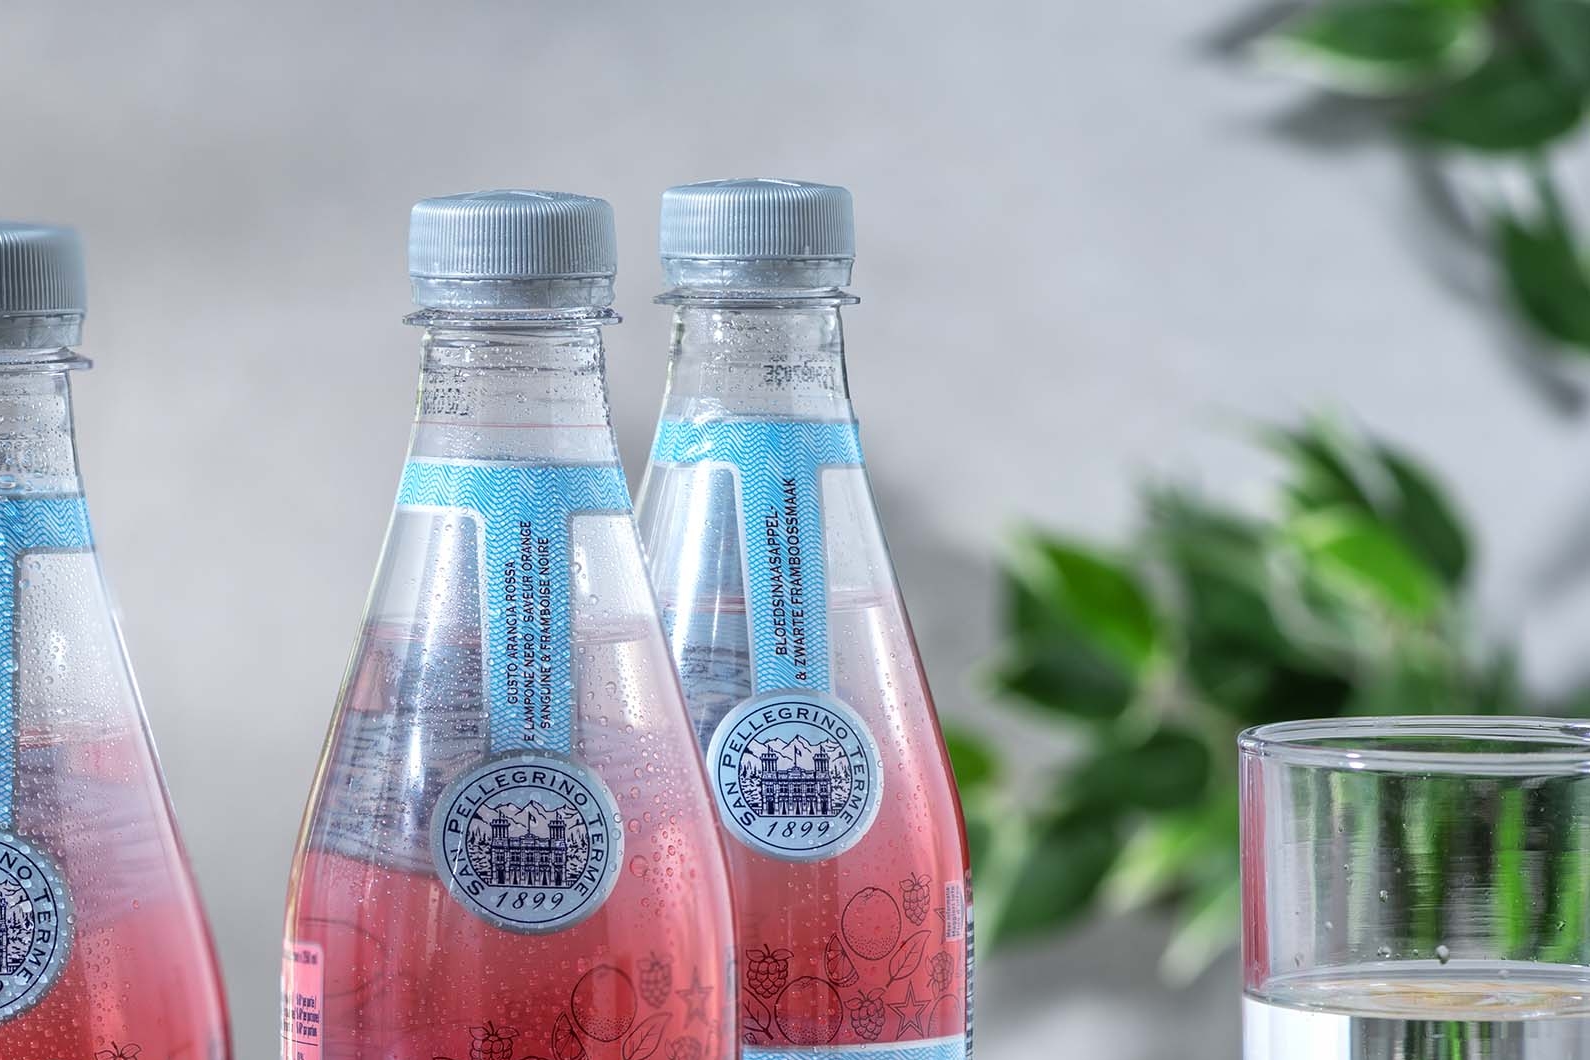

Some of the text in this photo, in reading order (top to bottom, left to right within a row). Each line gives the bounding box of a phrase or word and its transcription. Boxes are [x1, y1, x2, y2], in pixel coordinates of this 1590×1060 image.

[721, 707, 866, 826] SAN PELLEGRINO TERME
[447, 771, 604, 897] SAN PELLEGRINO TERME
[766, 821, 831, 839] 1899
[15, 888, 52, 985] TERME
[496, 891, 563, 909] 1899
